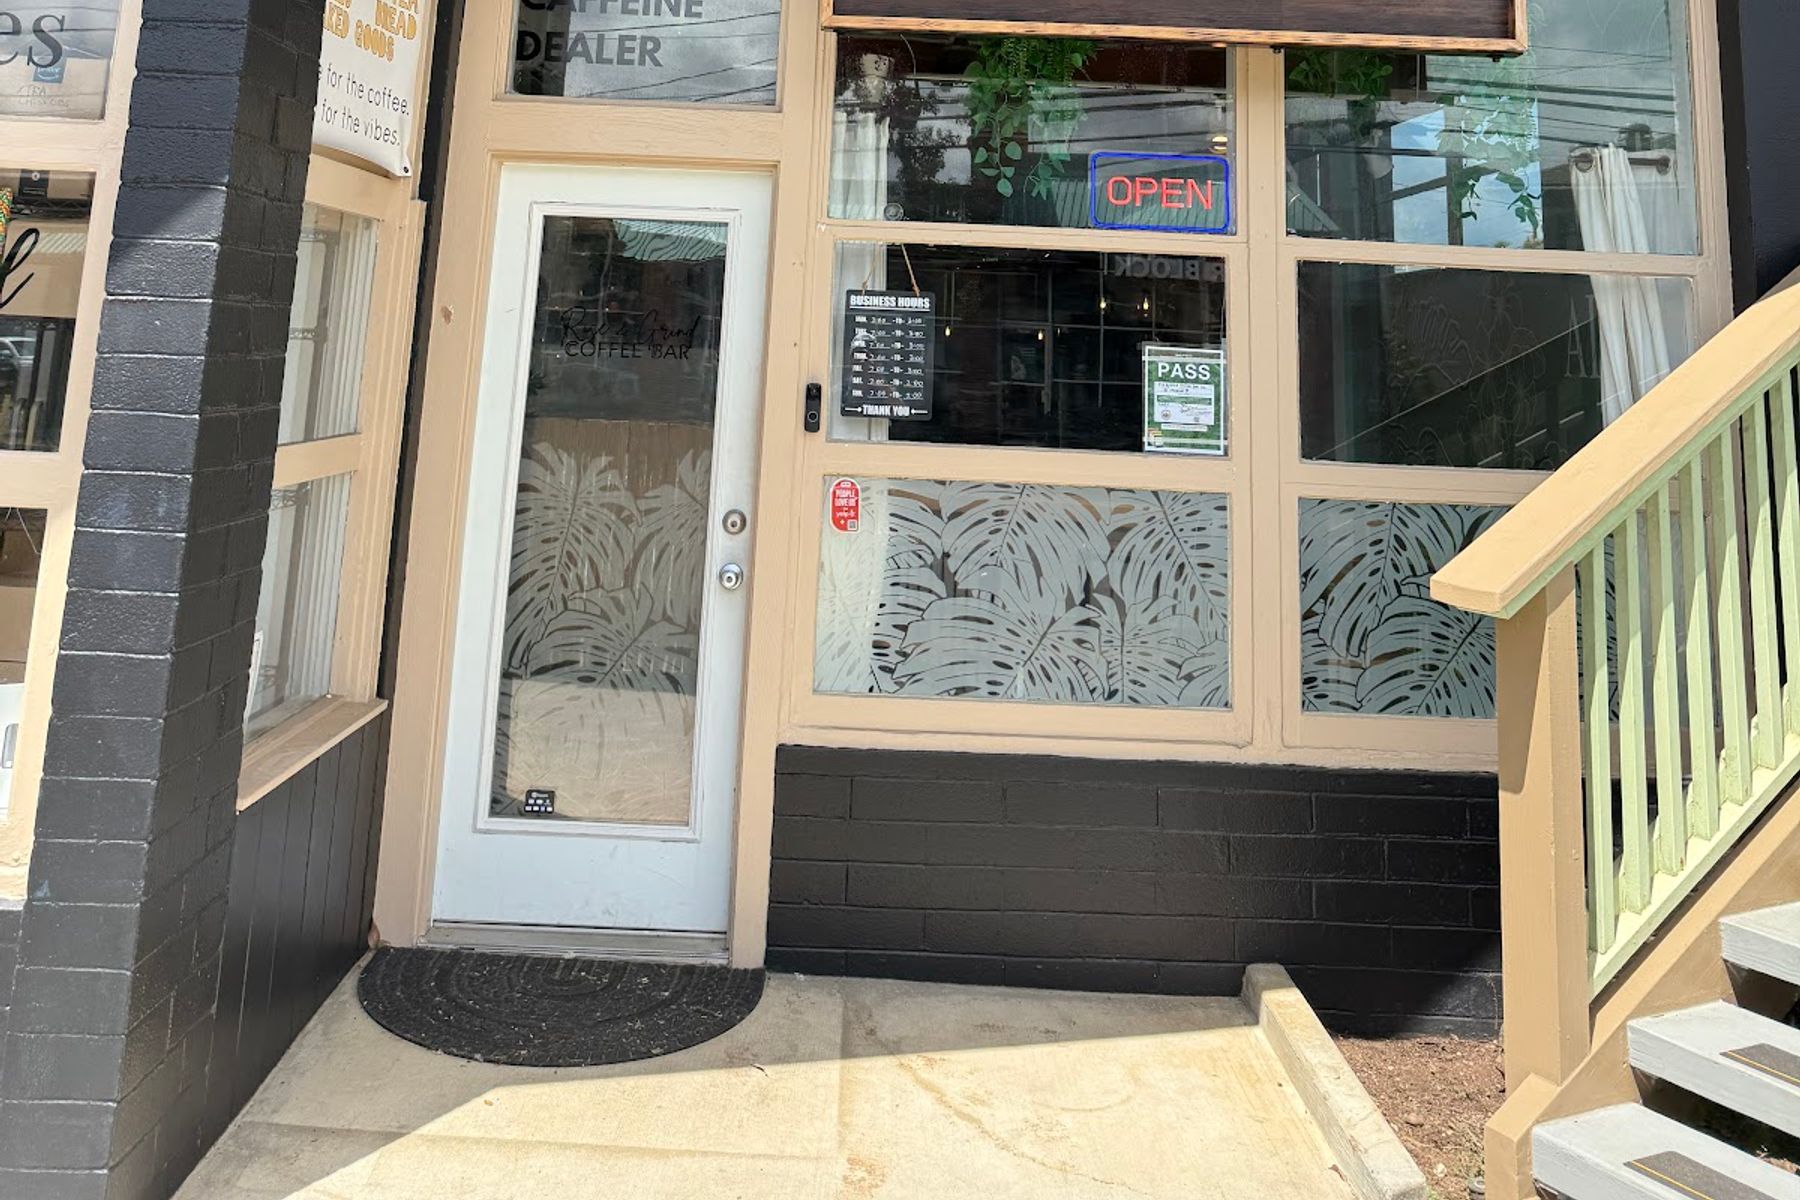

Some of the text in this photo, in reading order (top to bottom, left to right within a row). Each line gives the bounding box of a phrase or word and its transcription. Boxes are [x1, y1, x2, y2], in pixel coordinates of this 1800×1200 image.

[355, 19, 394, 62] GOODS
[517, 30, 663, 67] DEALER
[327, 63, 343, 88] for
[347, 72, 364, 99] the
[367, 87, 409, 116] coffee.
[321, 99, 400, 146] for the vibes.
[1107, 176, 1213, 209] OPEN
[850, 295, 930, 309] BUSINESS HOURS
[565, 340, 689, 360] COFFEE BAR
[1158, 362, 1211, 380] PASS
[863, 404, 910, 416] THANK YOU
